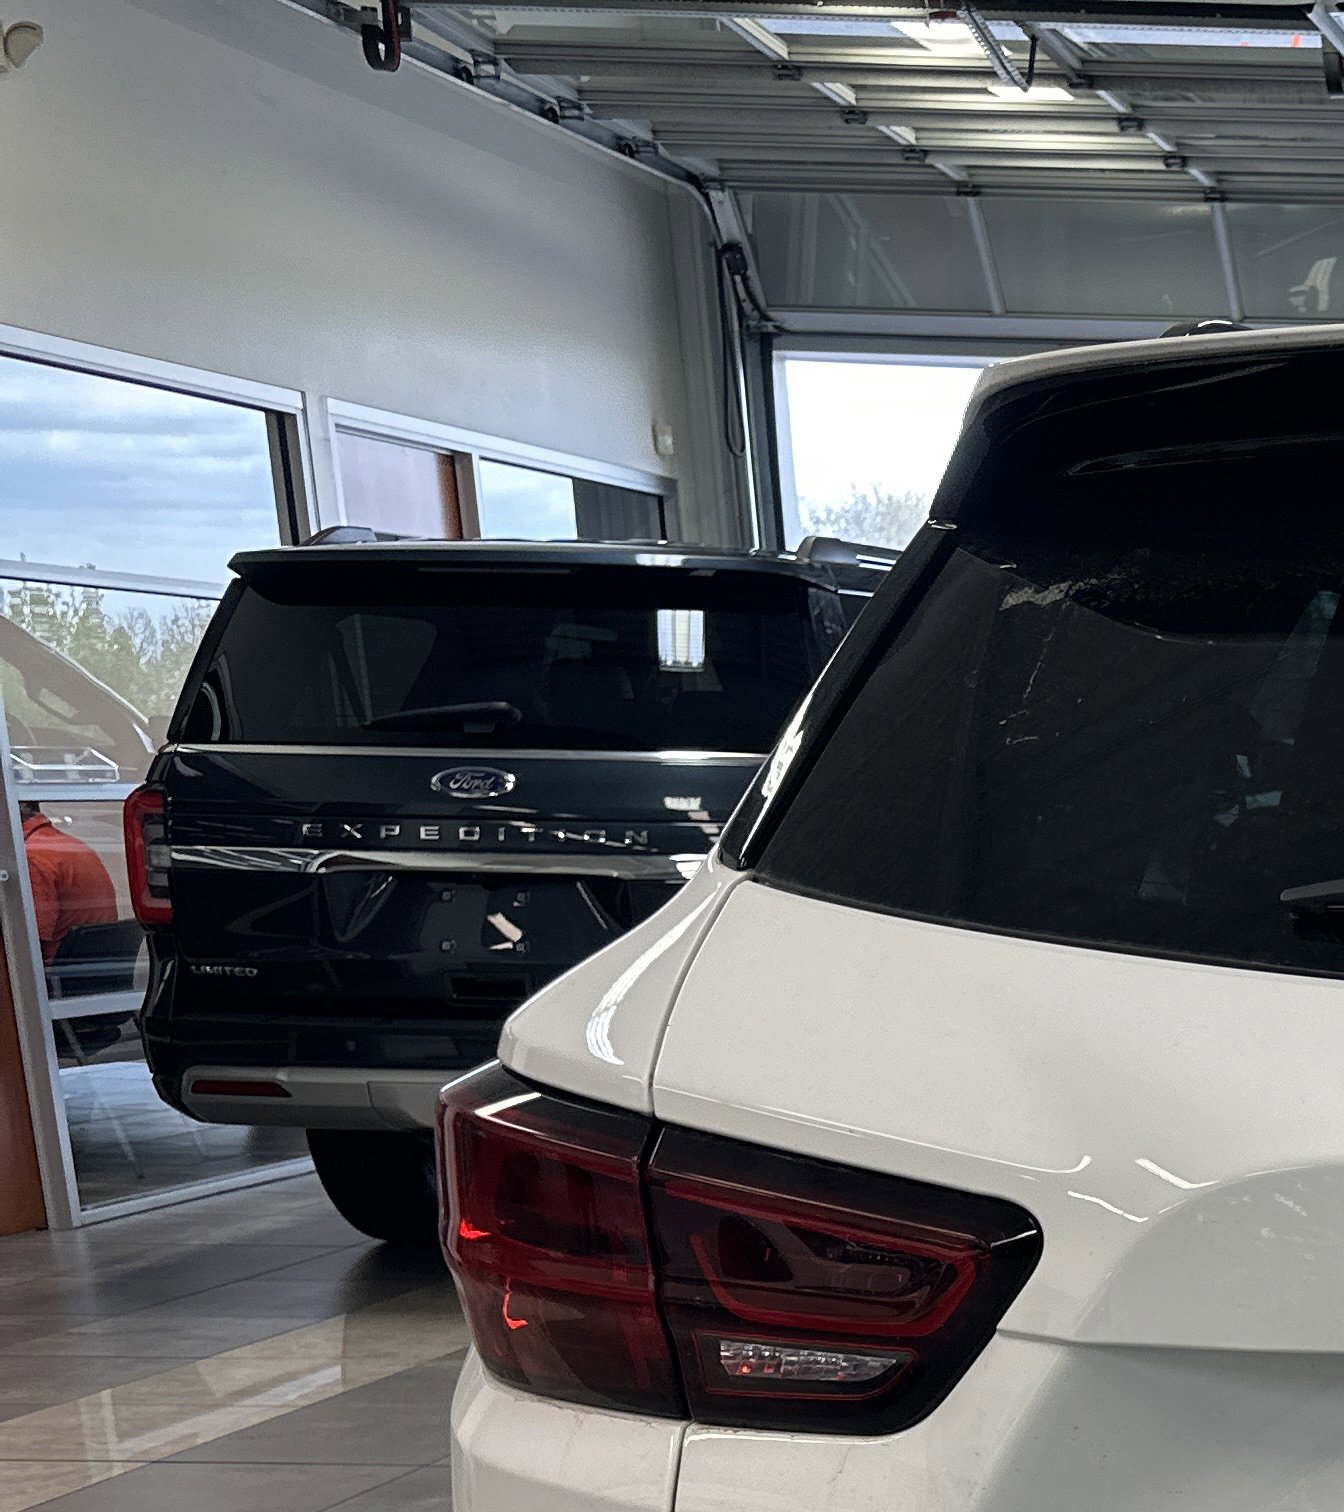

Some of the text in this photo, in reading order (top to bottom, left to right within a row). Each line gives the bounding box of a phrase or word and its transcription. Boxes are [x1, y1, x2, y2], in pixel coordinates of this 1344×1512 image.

[449, 771, 497, 790] Ford
[301, 822, 649, 848] EXPEDITION
[190, 965, 259, 978] LIMITED
